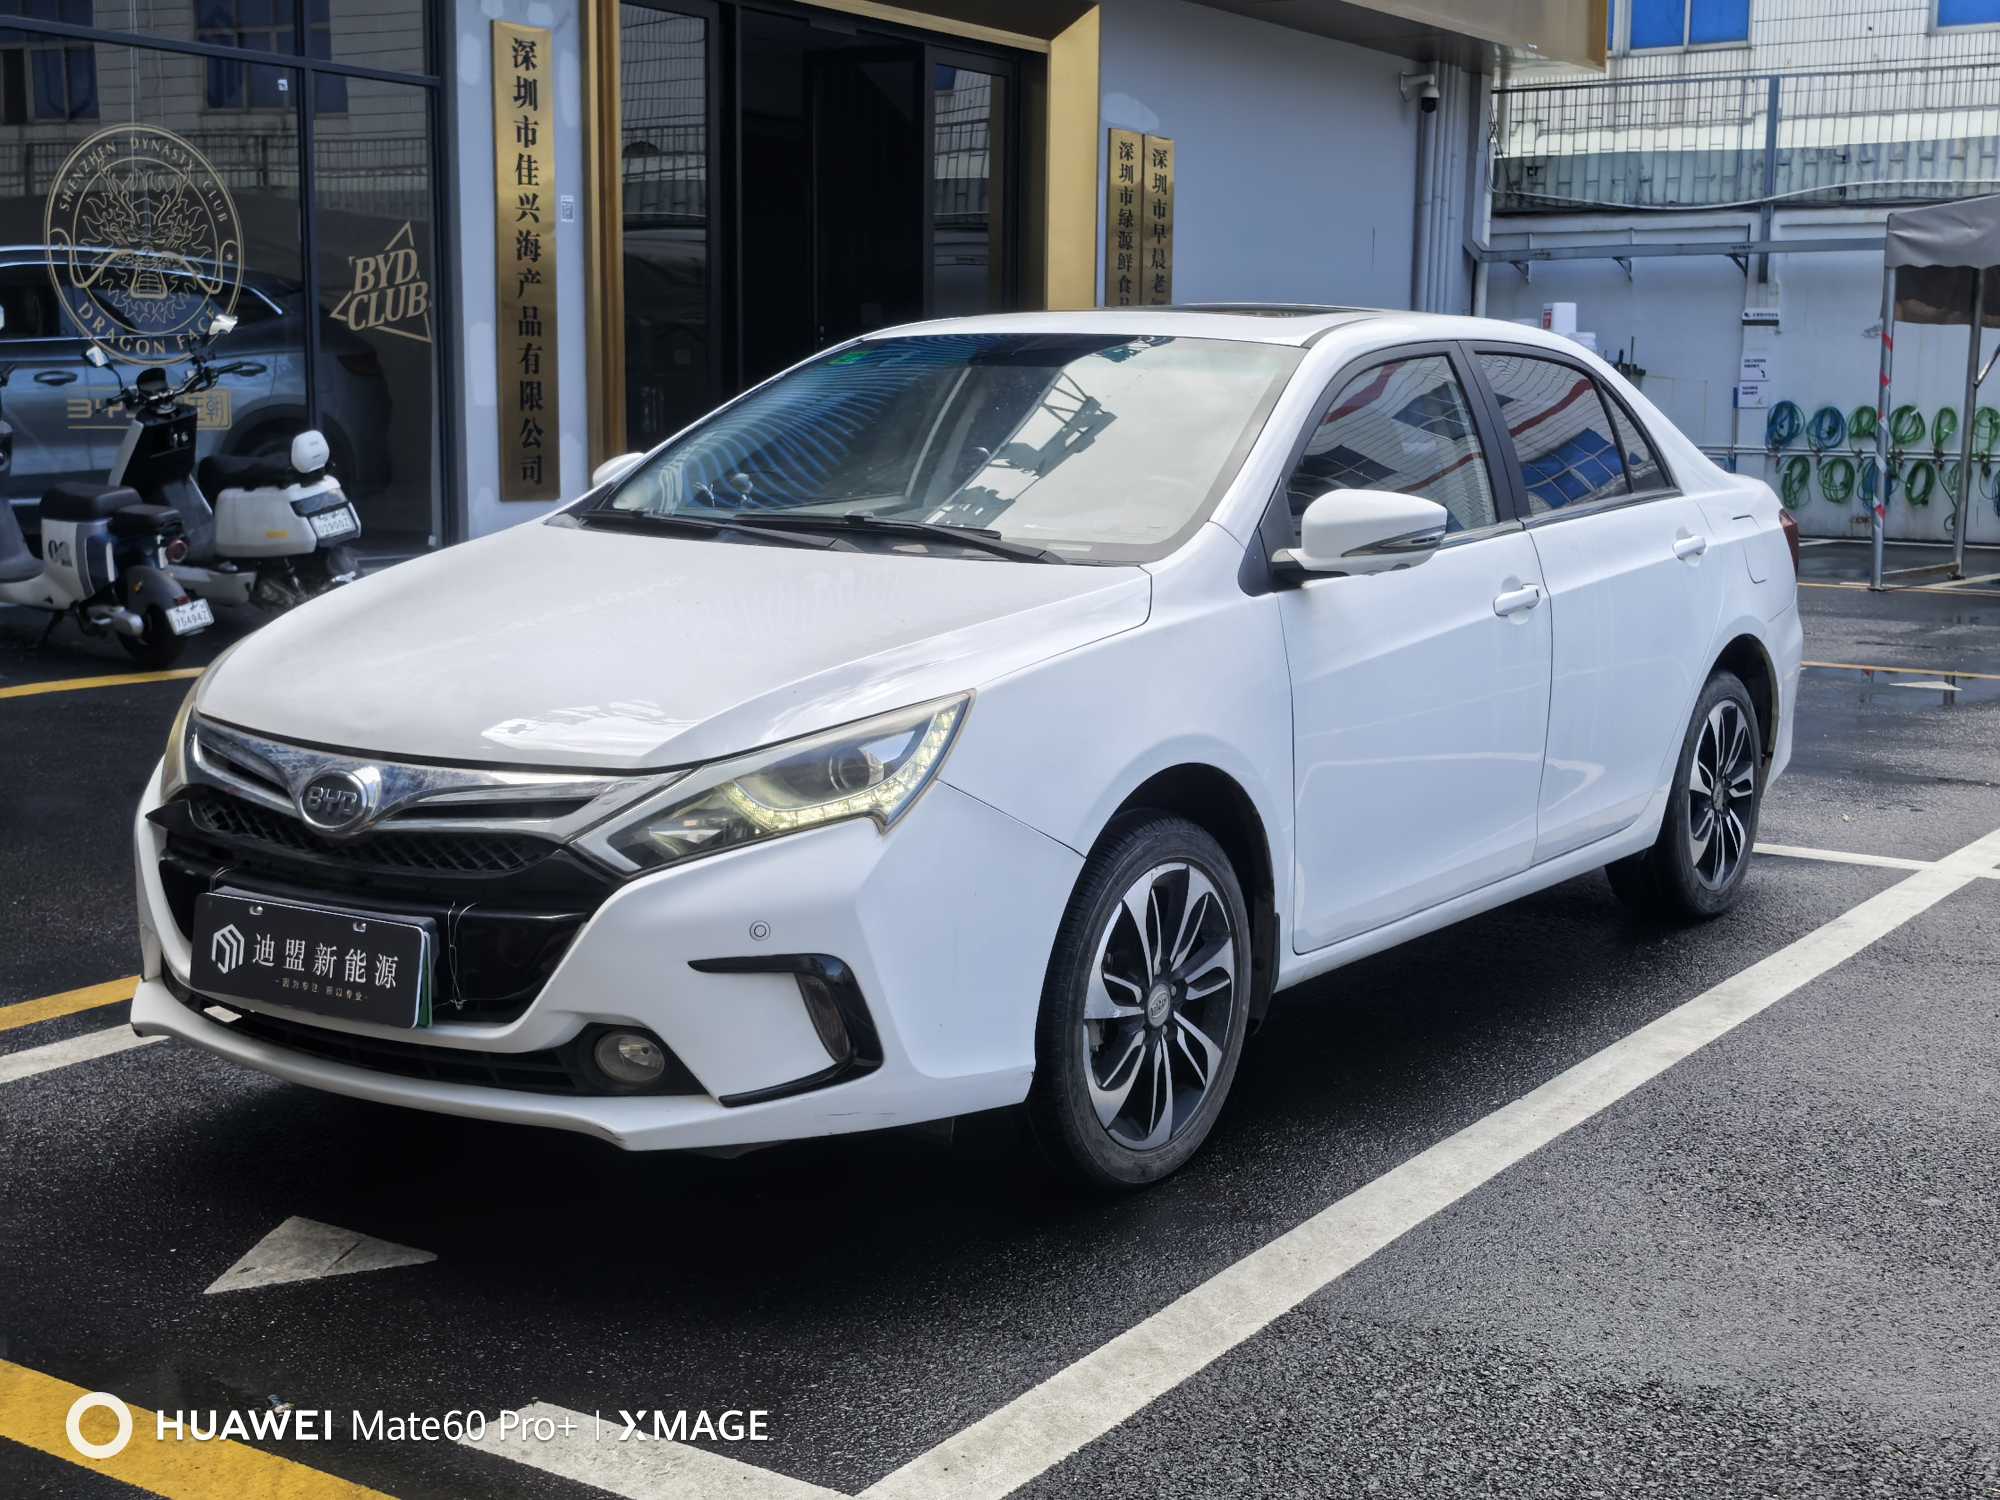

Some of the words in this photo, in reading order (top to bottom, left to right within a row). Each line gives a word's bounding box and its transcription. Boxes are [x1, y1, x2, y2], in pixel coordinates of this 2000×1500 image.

[59, 142, 117, 212] SHENZHEN
[130, 136, 193, 171] DYNASTY
[202, 180, 228, 223] CLUB
[1151, 148, 1168, 304] 深圳市早晨老
[353, 248, 418, 295] BYD
[512, 37, 544, 486] 深圳市佳兴海产品有限公司
[78, 302, 165, 354] DRAGON
[347, 281, 429, 332] CLUB
[308, 785, 358, 815] BYD
[252, 933, 399, 988] 迪盟新能源
